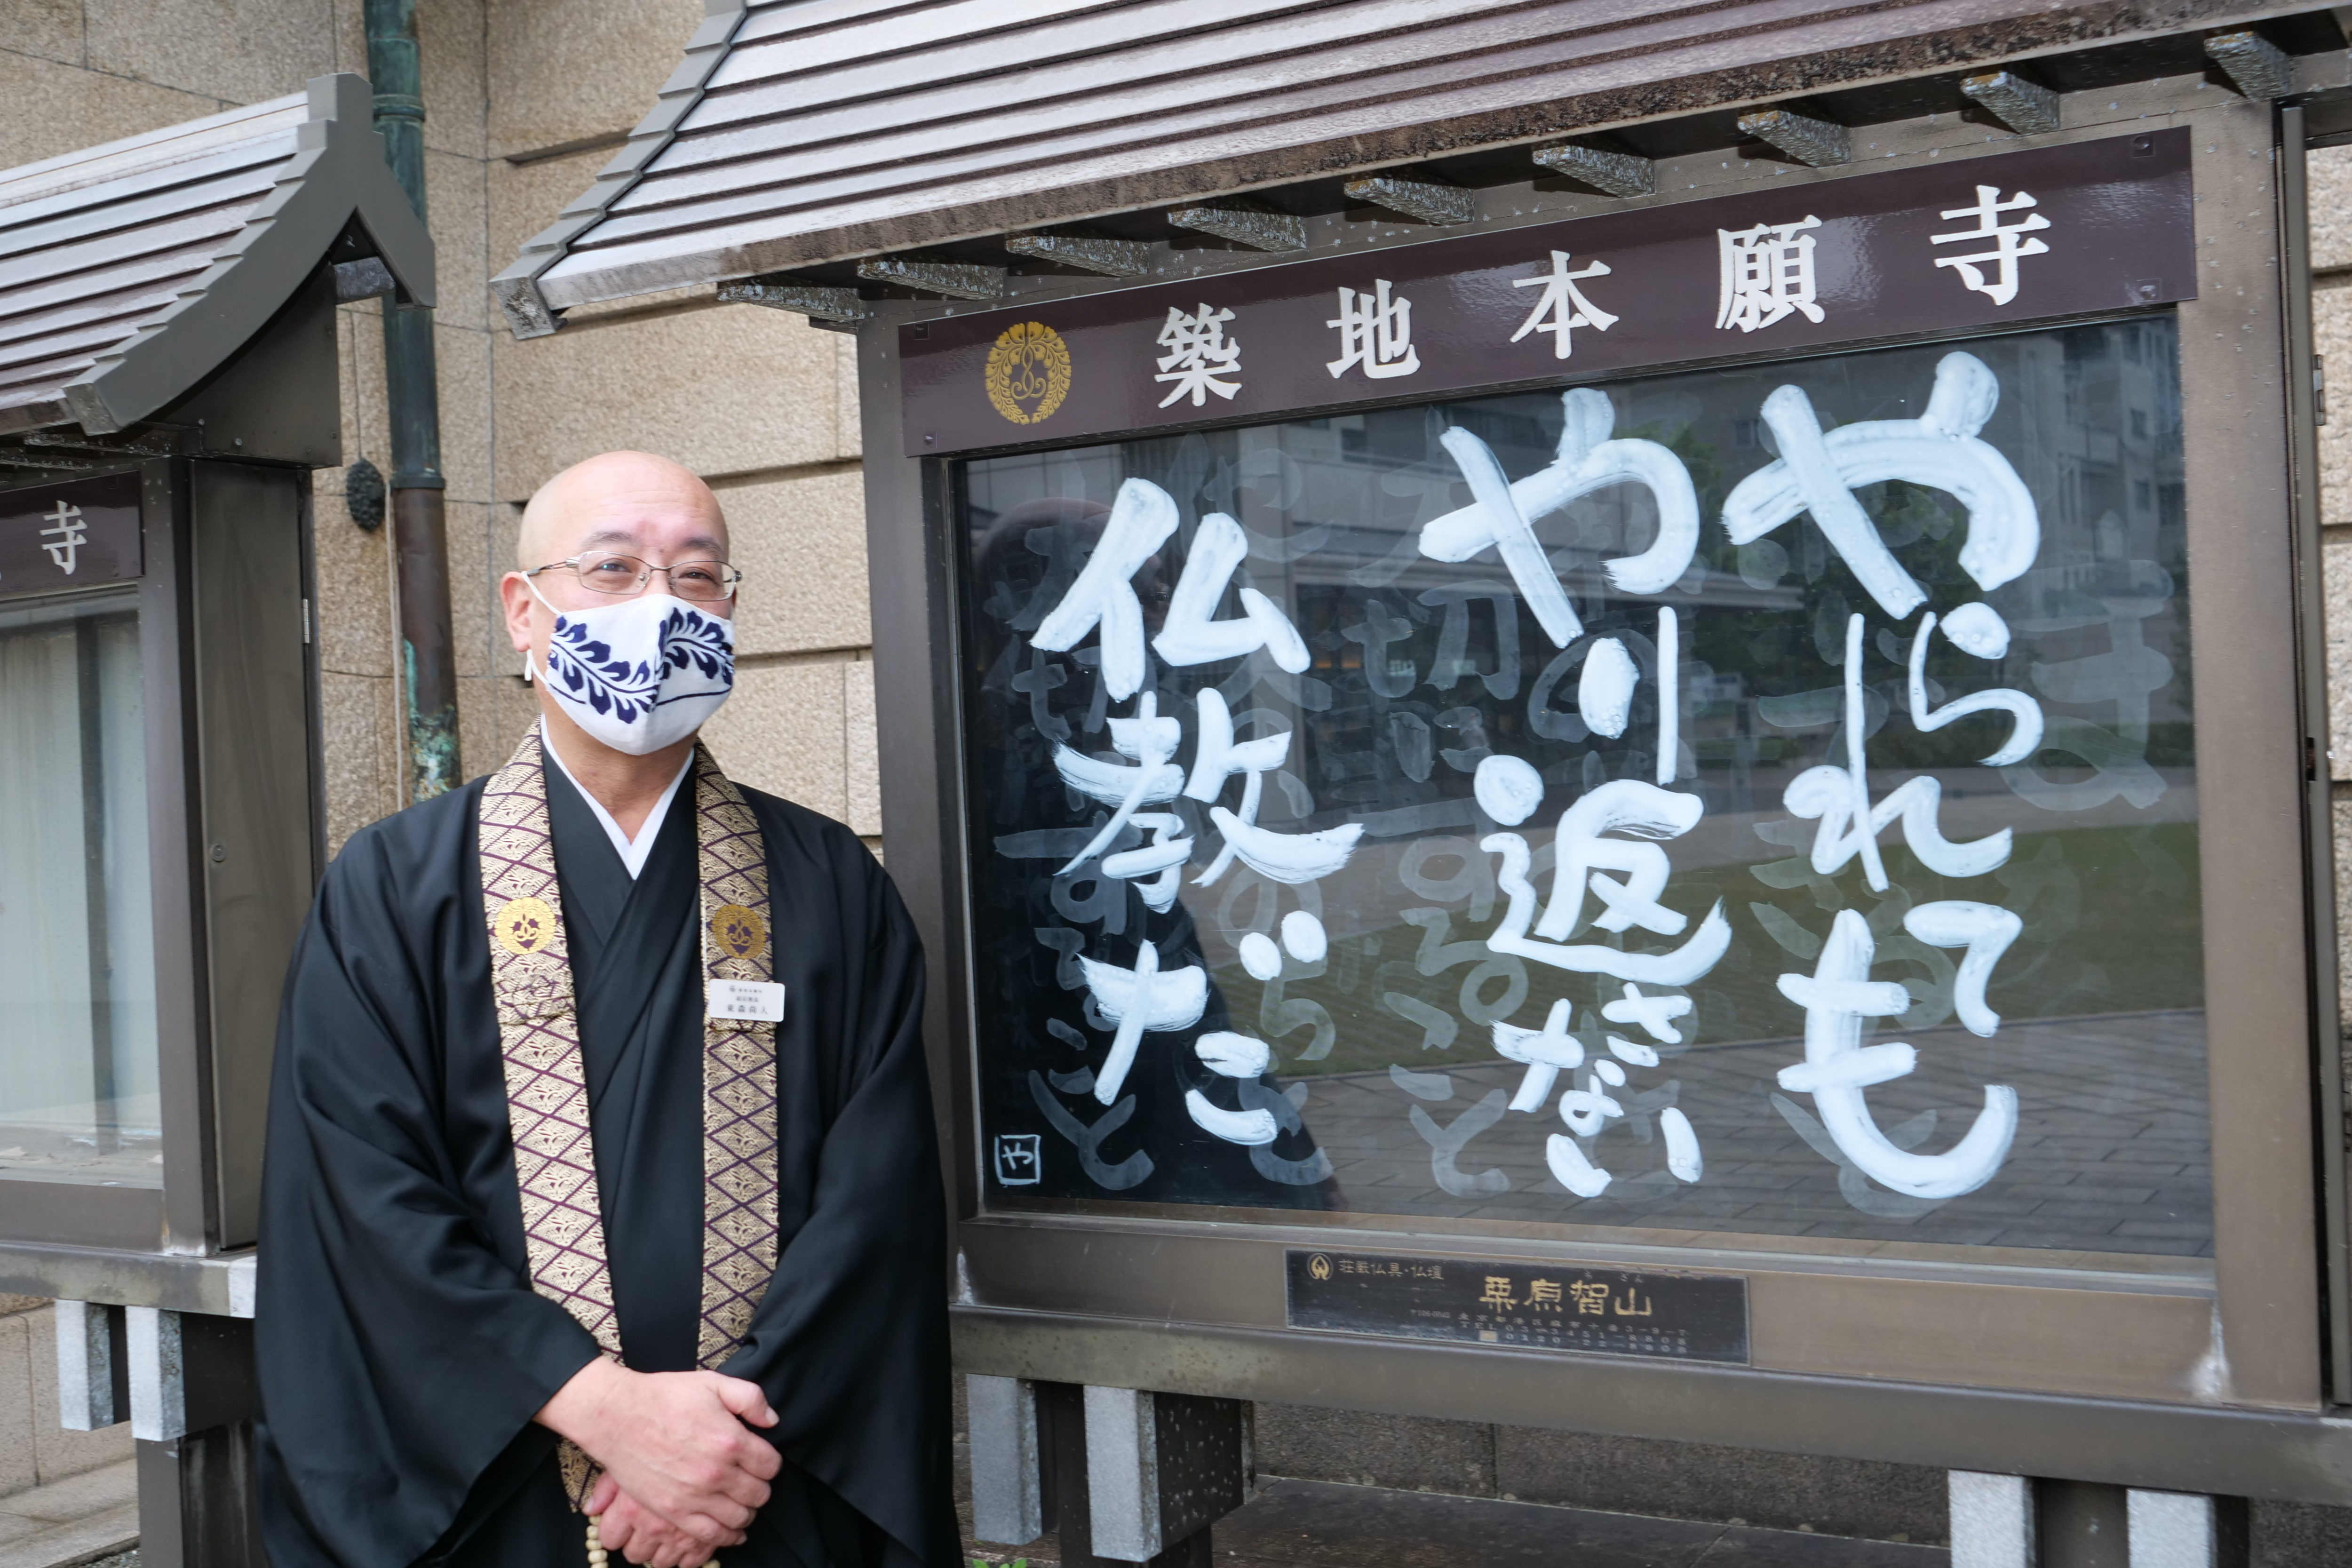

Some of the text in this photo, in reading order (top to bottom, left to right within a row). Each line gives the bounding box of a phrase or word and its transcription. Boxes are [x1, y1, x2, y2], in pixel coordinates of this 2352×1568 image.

[1154, 184, 2051, 409] 築地本願寺
[1418, 387, 1732, 1198] やり返さない
[1719, 350, 2043, 1199] やられても
